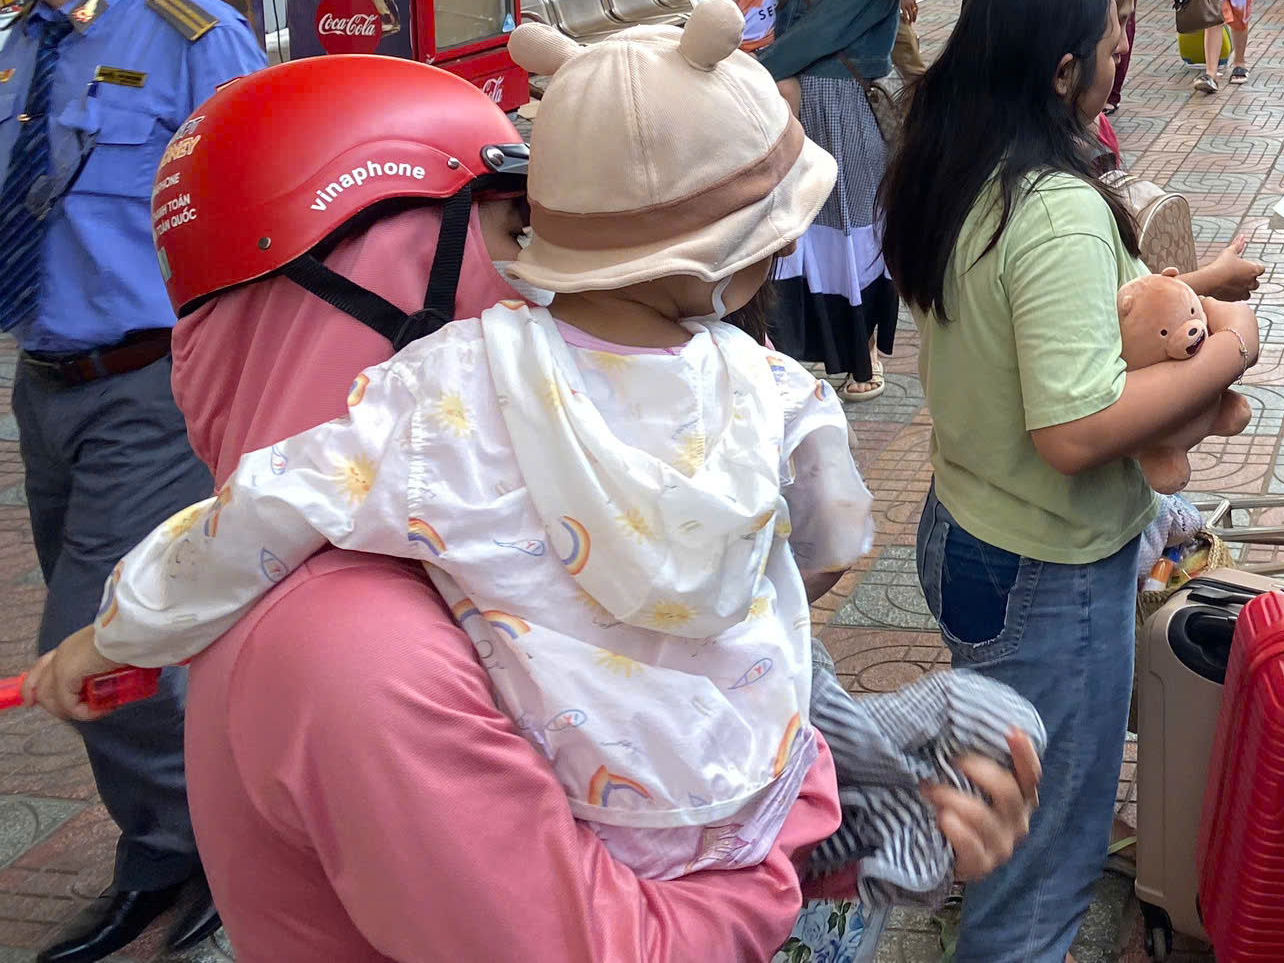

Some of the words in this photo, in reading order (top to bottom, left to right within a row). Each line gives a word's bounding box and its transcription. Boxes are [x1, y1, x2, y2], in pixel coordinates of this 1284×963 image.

[758, 4, 777, 20] SE
[318, 13, 378, 36] Coca-Cola
[310, 160, 426, 212] vinaphone
